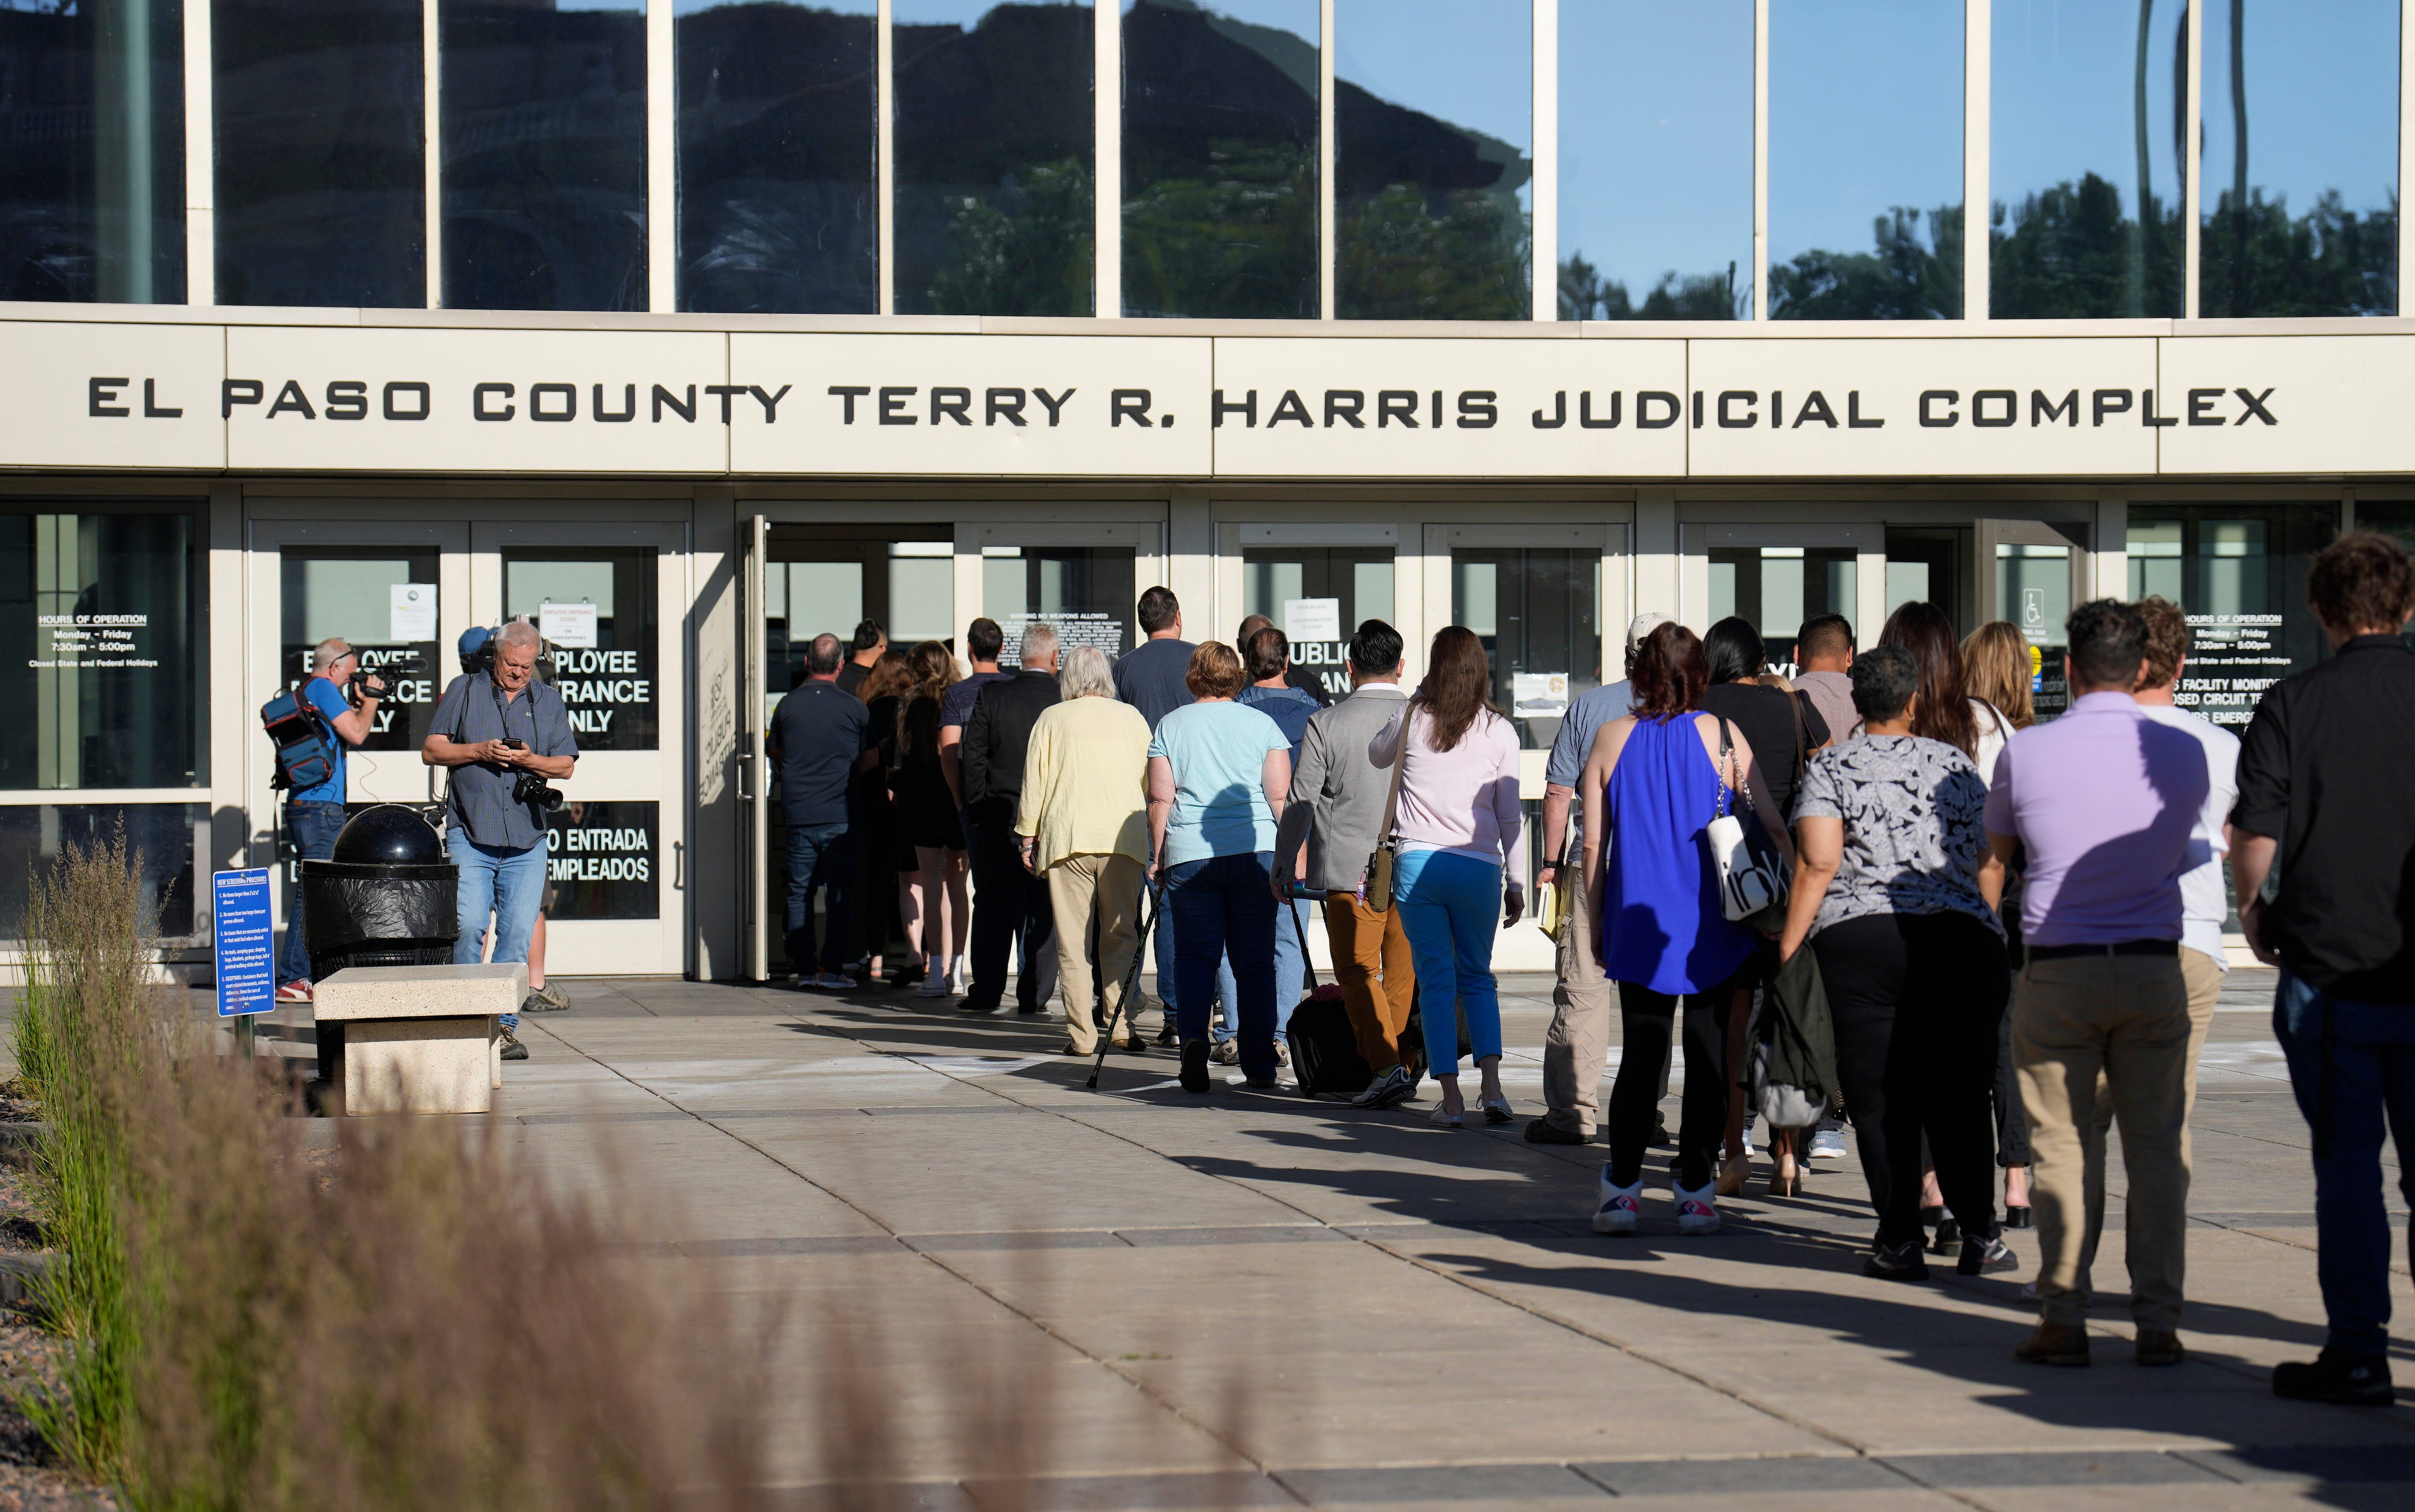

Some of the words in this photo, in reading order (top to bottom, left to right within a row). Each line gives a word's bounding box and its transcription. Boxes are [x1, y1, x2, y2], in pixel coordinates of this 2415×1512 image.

[89, 377, 183, 418] EL
[222, 379, 429, 421] PASO
[474, 383, 792, 423] COUNTY
[828, 386, 1077, 427] TERRY
[1112, 389, 1174, 428] R.
[1213, 389, 1498, 429] HARRIS
[1532, 390, 1884, 429] JUDICIAL
[1920, 388, 2279, 428] COMPLEX
[39, 615, 73, 624] HOURS
[76, 615, 90, 624] OF
[93, 615, 147, 624] OPERATION
[2185, 615, 2214, 623] HOURS
[2218, 615, 2230, 623] OF
[2233, 614, 2282, 623] OPERATION
[54, 630, 91, 640] Monday
[103, 630, 132, 640] Friday
[2196, 629, 2231, 639] Monday
[2241, 629, 2268, 639] Friday
[51, 642, 87, 652] 7:30am
[99, 642, 135, 653] 5:00pm
[2194, 641, 2227, 650] 7:30am
[2237, 641, 2271, 651] 5:00pm
[1290, 642, 1351, 665] UBLI
[126, 659, 158, 668] Holidays
[551, 650, 637, 674] PLOYEE
[2262, 657, 2291, 666] Holidays
[2182, 678, 2229, 691] FACILITY
[2232, 678, 2286, 691] MONITO
[558, 679, 650, 703] RANCE
[2203, 693, 2248, 705] CIRCUIT
[568, 710, 614, 733] NLY
[2212, 712, 2255, 725] EMERG
[546, 828, 560, 852] O
[567, 828, 649, 851] ENTRADA
